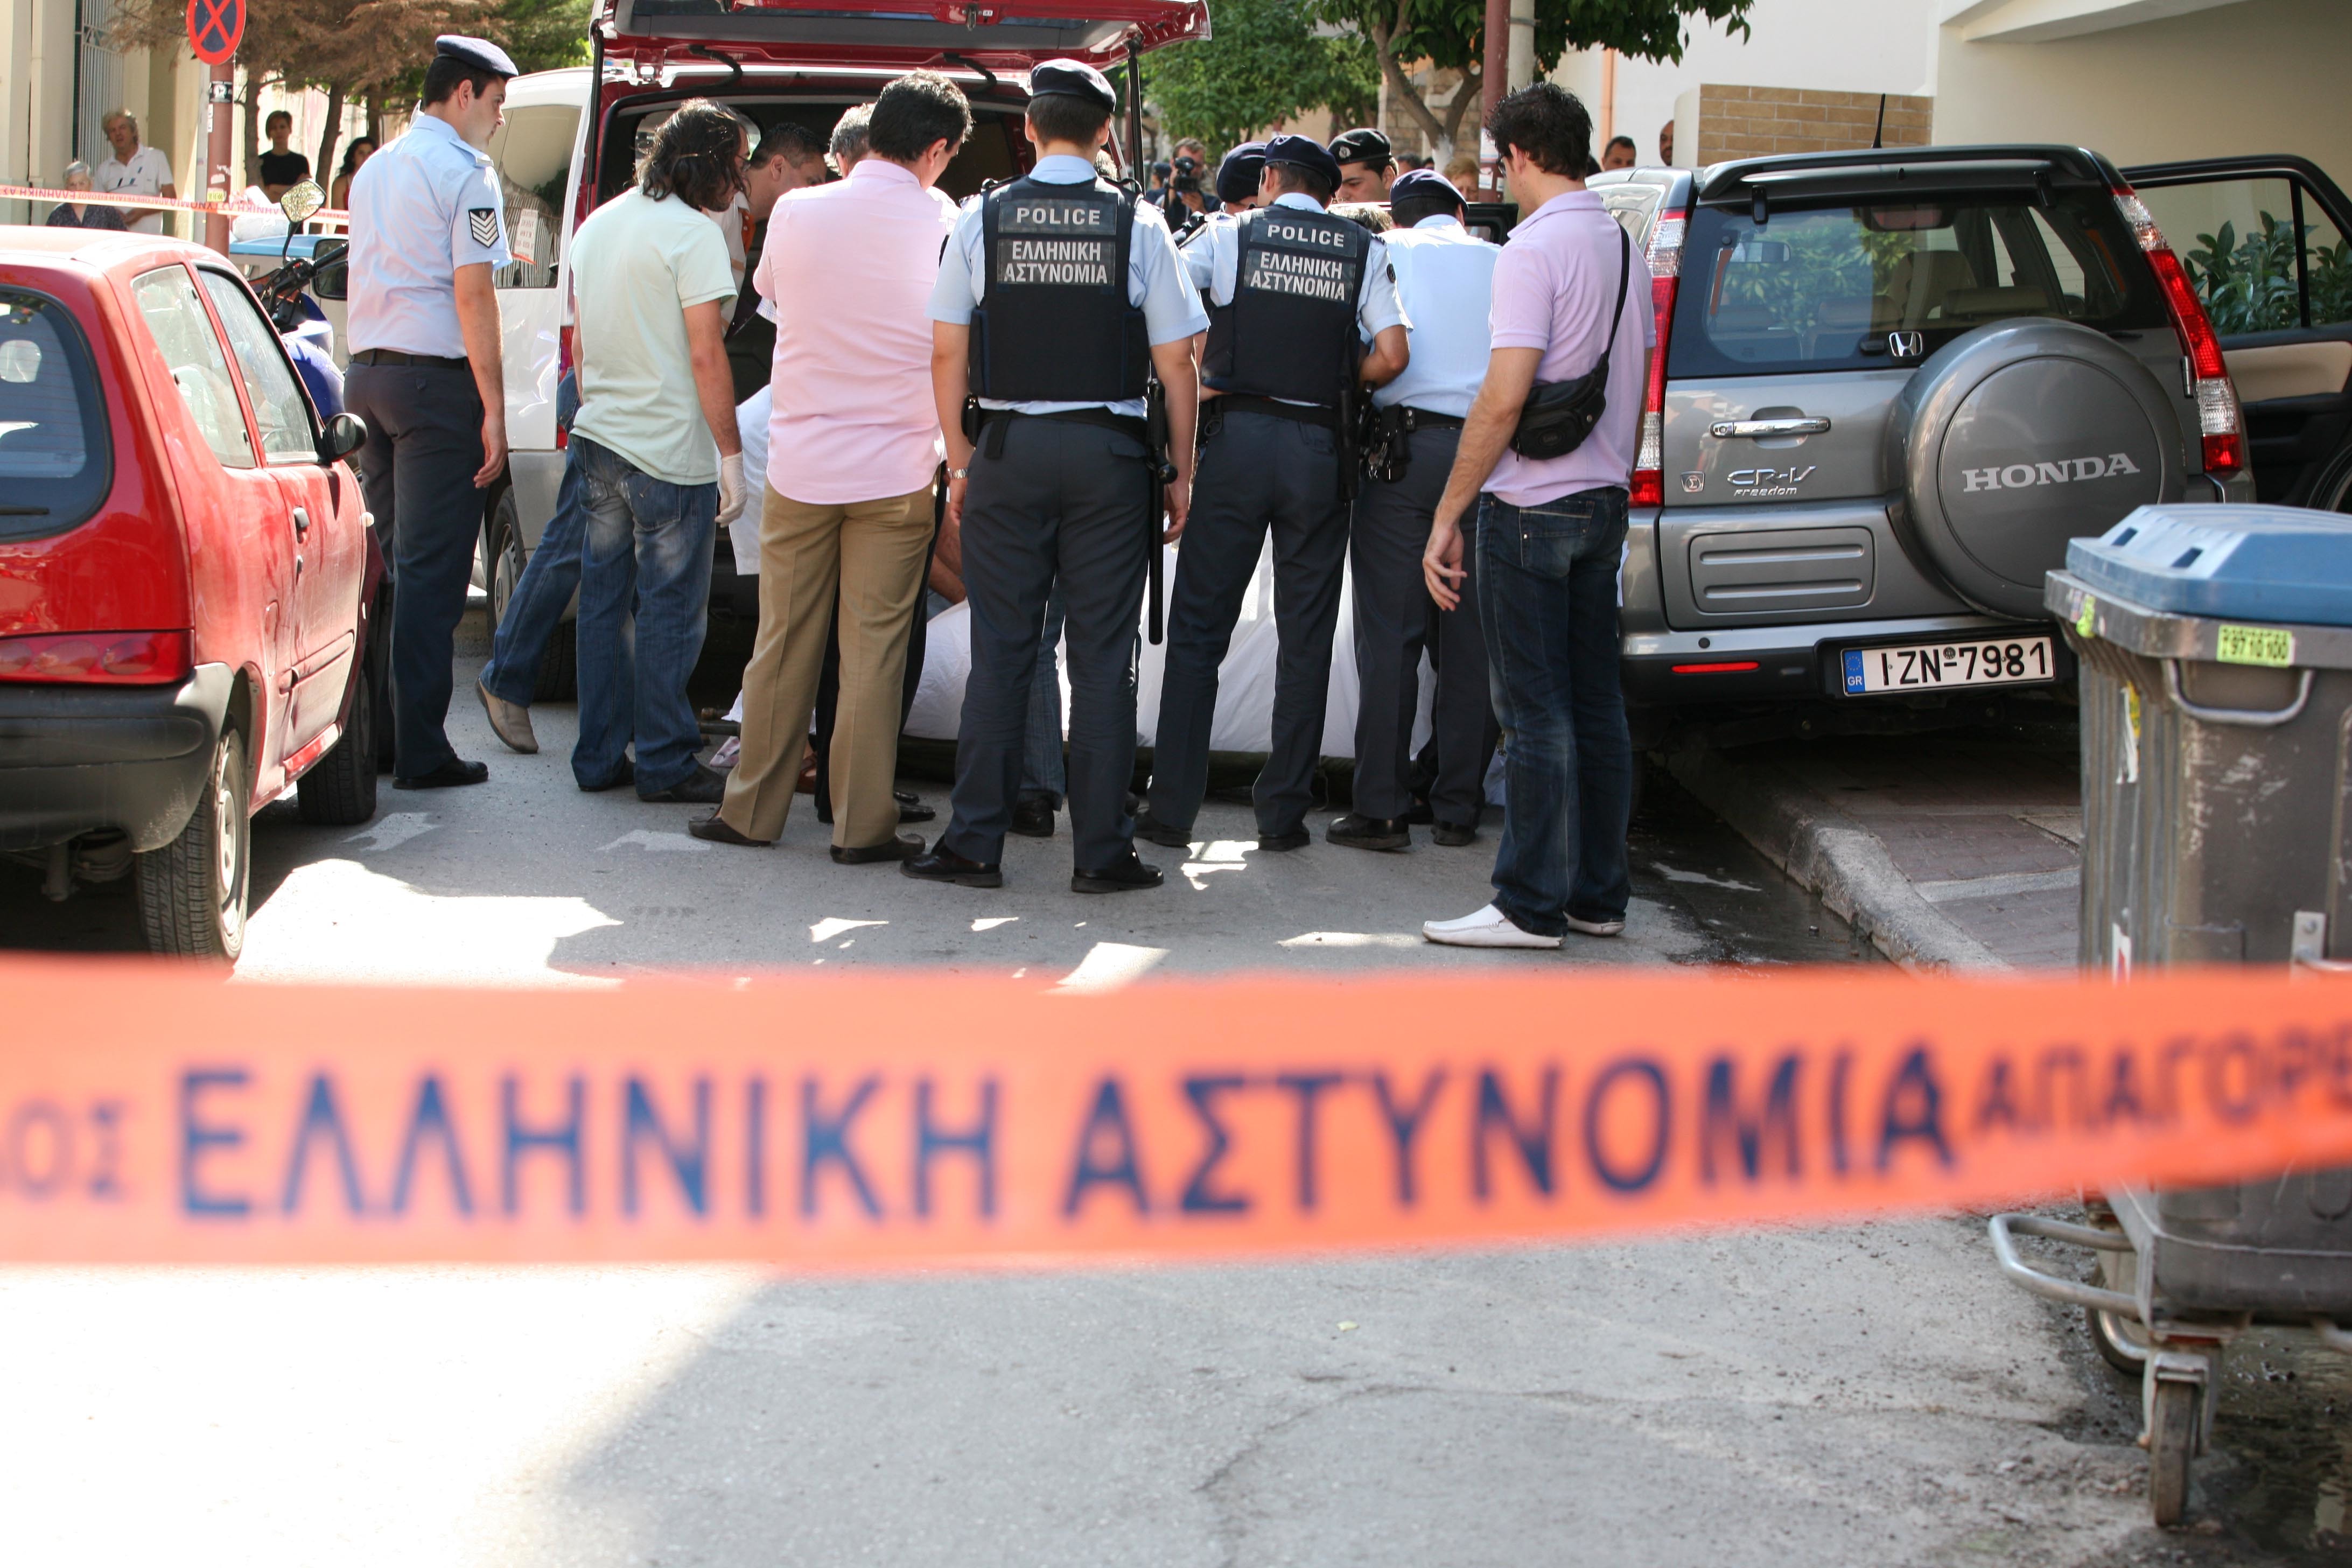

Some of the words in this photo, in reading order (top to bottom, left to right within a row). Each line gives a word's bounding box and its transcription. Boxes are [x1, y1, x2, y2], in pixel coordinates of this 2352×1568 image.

[20, 188, 75, 200] ΕΛΛΗΝΙΚΗ
[237, 204, 285, 215] ΛΛΗΝΙΚΗ
[1016, 207, 1101, 226] POLICE
[1267, 224, 1345, 248] POLICE
[1012, 240, 1101, 262] ΕΛΛΗΝΙΚΗ
[1003, 263, 1108, 284] ΑΣΤΥΝΟΜΙΑ
[1260, 251, 1343, 280] ΕΛΛΗΝΙΚΗ
[1250, 270, 1346, 302] ΑΣΤΥΝΟΜΙΑ
[1727, 465, 1817, 486] CR-V
[1962, 453, 2140, 493] HONDA
[1733, 485, 1798, 497] Freedom
[1847, 676, 1863, 686] GR
[0, 1096, 127, 1202] ΟΣ
[177, 1067, 999, 1221] ΕΛΛΗΝΙΚΗ
[1059, 1040, 1956, 1220] ΑΣΤΥΝΟΜΙΑ
